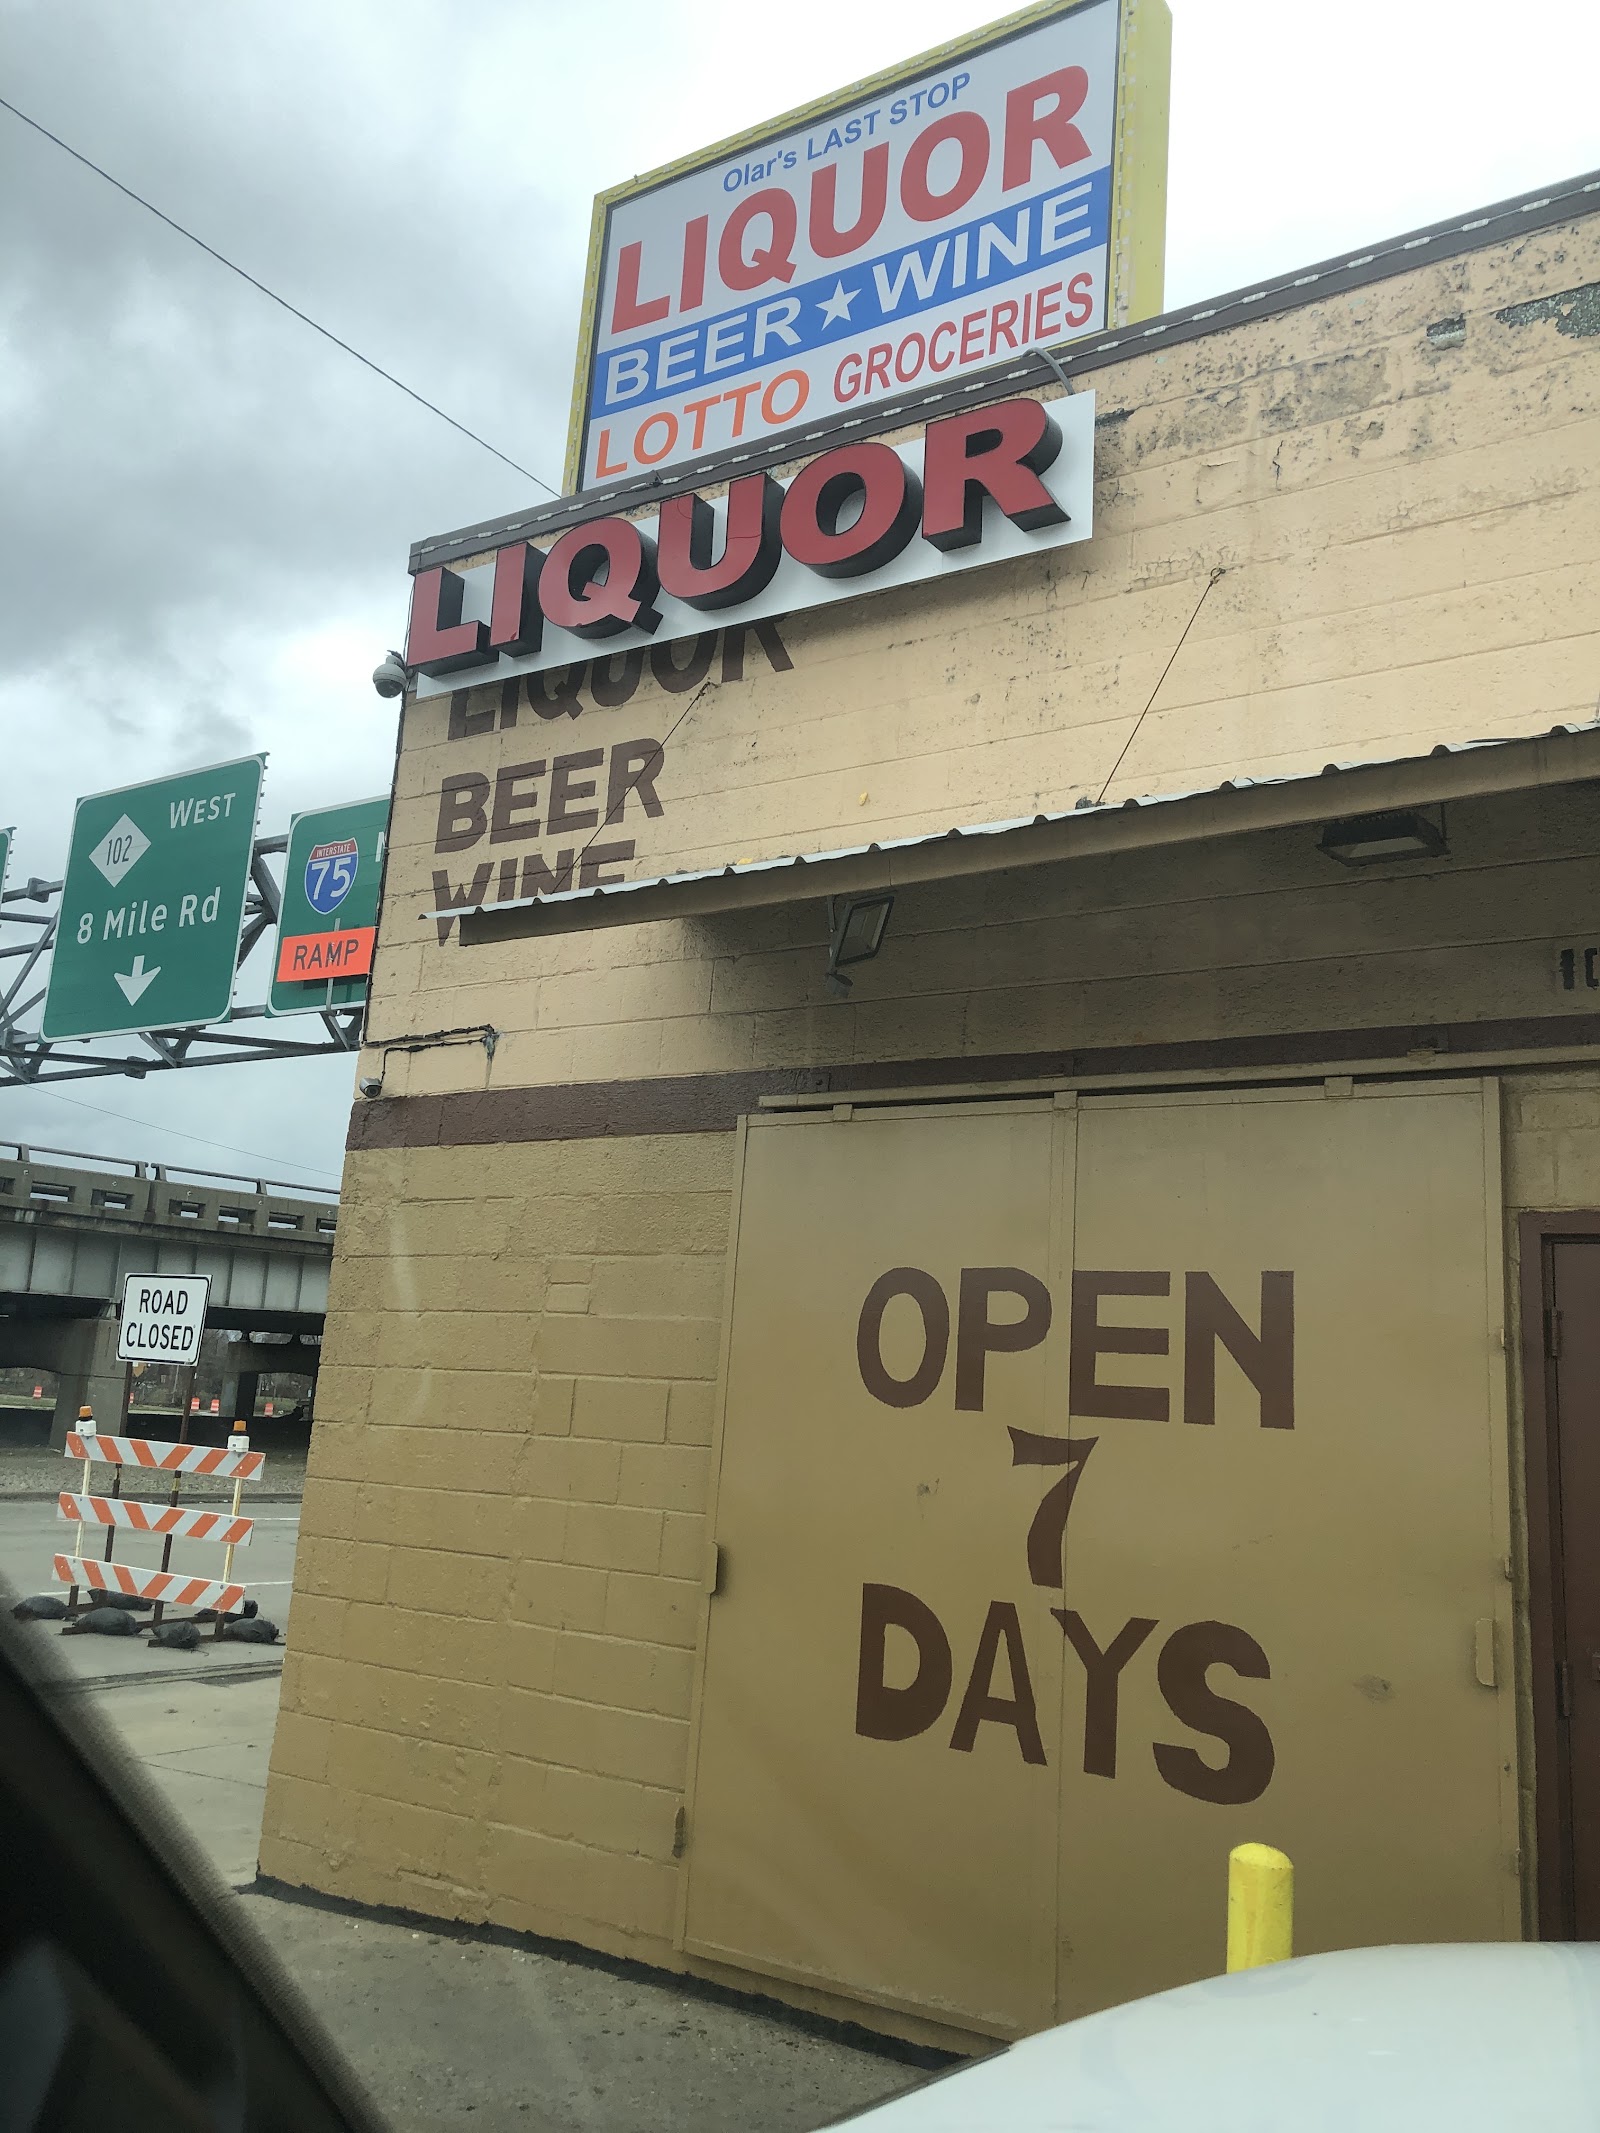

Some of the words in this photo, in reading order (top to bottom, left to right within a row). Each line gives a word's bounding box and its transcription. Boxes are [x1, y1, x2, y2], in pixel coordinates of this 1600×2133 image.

[723, 150, 797, 192] Olar's
[807, 109, 881, 160] LAST
[889, 72, 971, 125] STOP
[611, 65, 1092, 334] LIQUOR
[605, 299, 802, 406] BEER
[871, 181, 1094, 314] WINE
[595, 369, 810, 479] LOTTO
[833, 272, 1094, 403] GROCERIES
[407, 397, 1070, 672] LIQUOR
[105, 834, 133, 866] 102
[169, 792, 236, 829] WEST
[316, 844, 351, 858] INTERSTATE
[435, 737, 666, 854] BEER
[77, 913, 94, 944] 8
[103, 900, 167, 941] Mile
[179, 887, 221, 928] Rd
[311, 857, 351, 900] 75
[293, 939, 359, 971] RAMP
[126, 1322, 194, 1352] CLOSED
[139, 1288, 188, 1315] ROAD
[857, 1266, 1294, 1429] OPEN
[1007, 1425, 1099, 1589] 7
[856, 1582, 1275, 1805] DAYS
